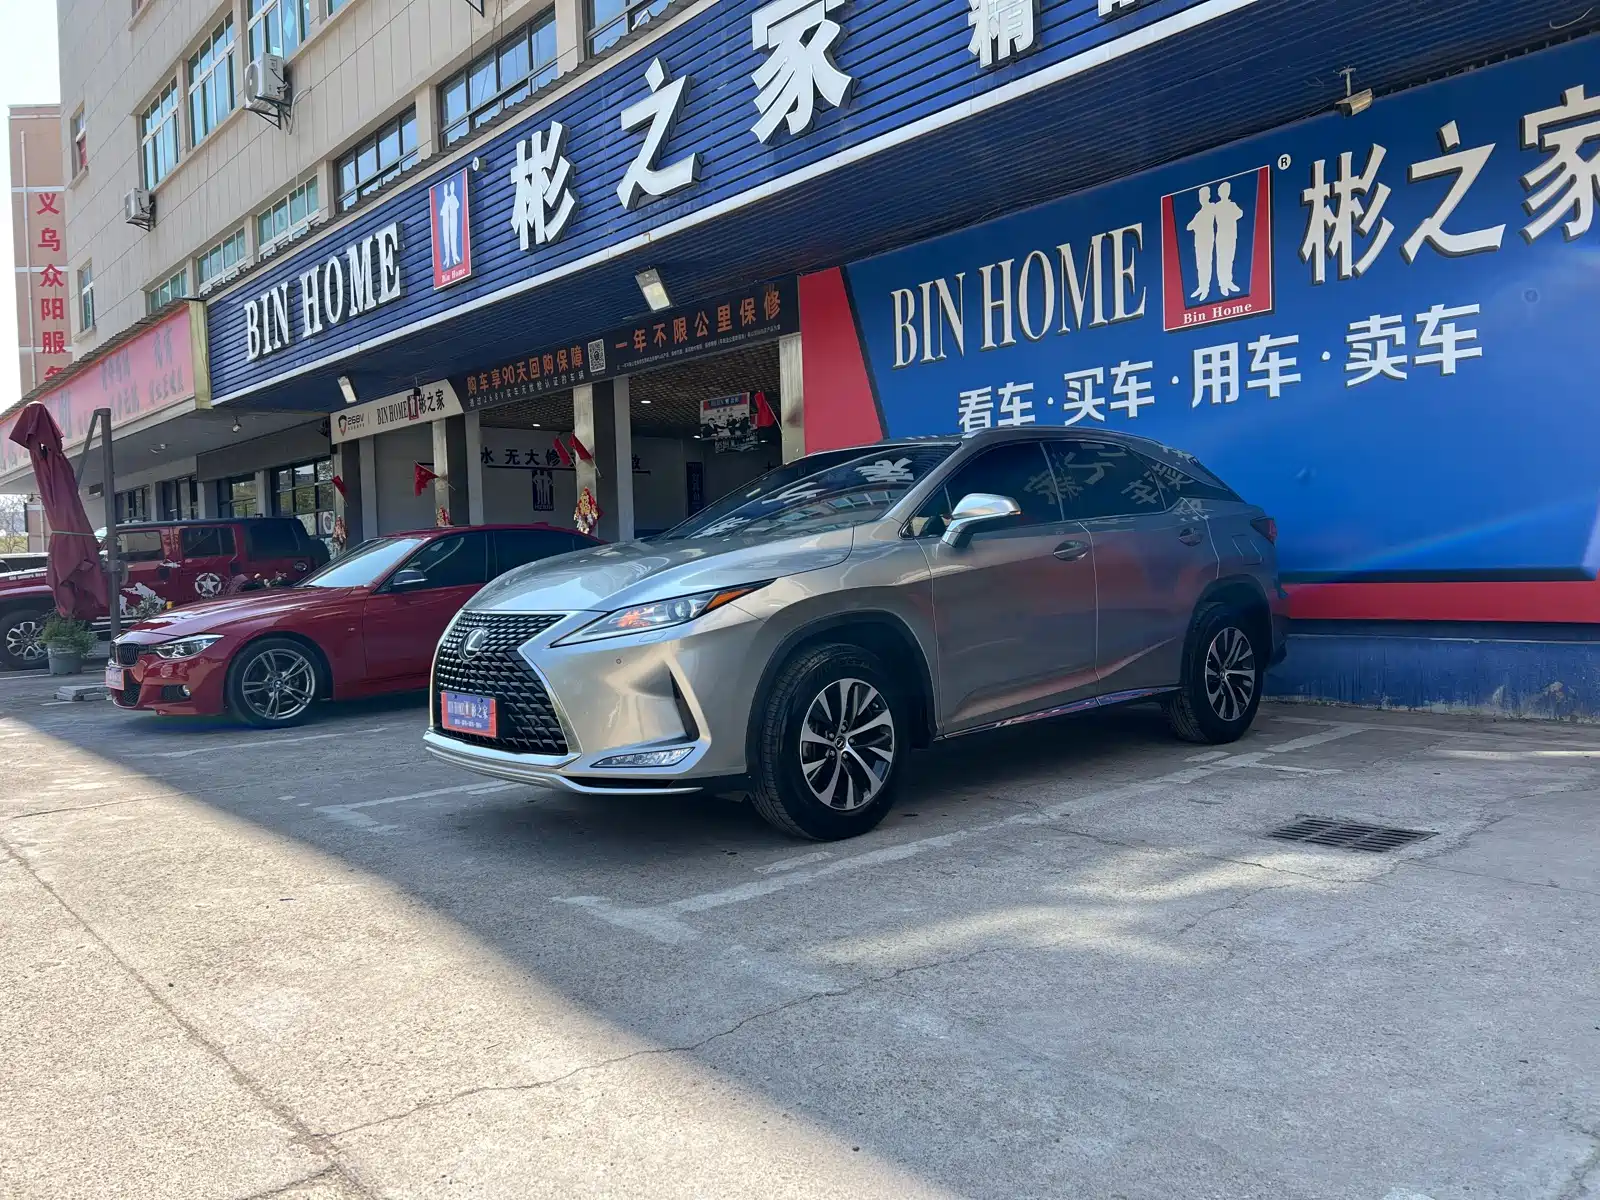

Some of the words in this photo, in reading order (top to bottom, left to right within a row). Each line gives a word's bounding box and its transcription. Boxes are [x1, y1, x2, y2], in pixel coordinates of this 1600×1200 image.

[510, 0, 853, 251] 彬之家
[1300, 85, 1600, 285] 彬之家
[244, 283, 290, 361] BIN
[300, 222, 401, 338] HOME
[615, 288, 781, 353] 一年不限公里保修
[891, 272, 966, 369] BIN
[979, 222, 1146, 352] HOME
[1182, 310, 1206, 325] Bin
[1211, 301, 1253, 320] Home
[376, 407, 389, 425] BIN
[389, 400, 409, 423] HOME
[466, 345, 584, 396] 购车享90天回购保障
